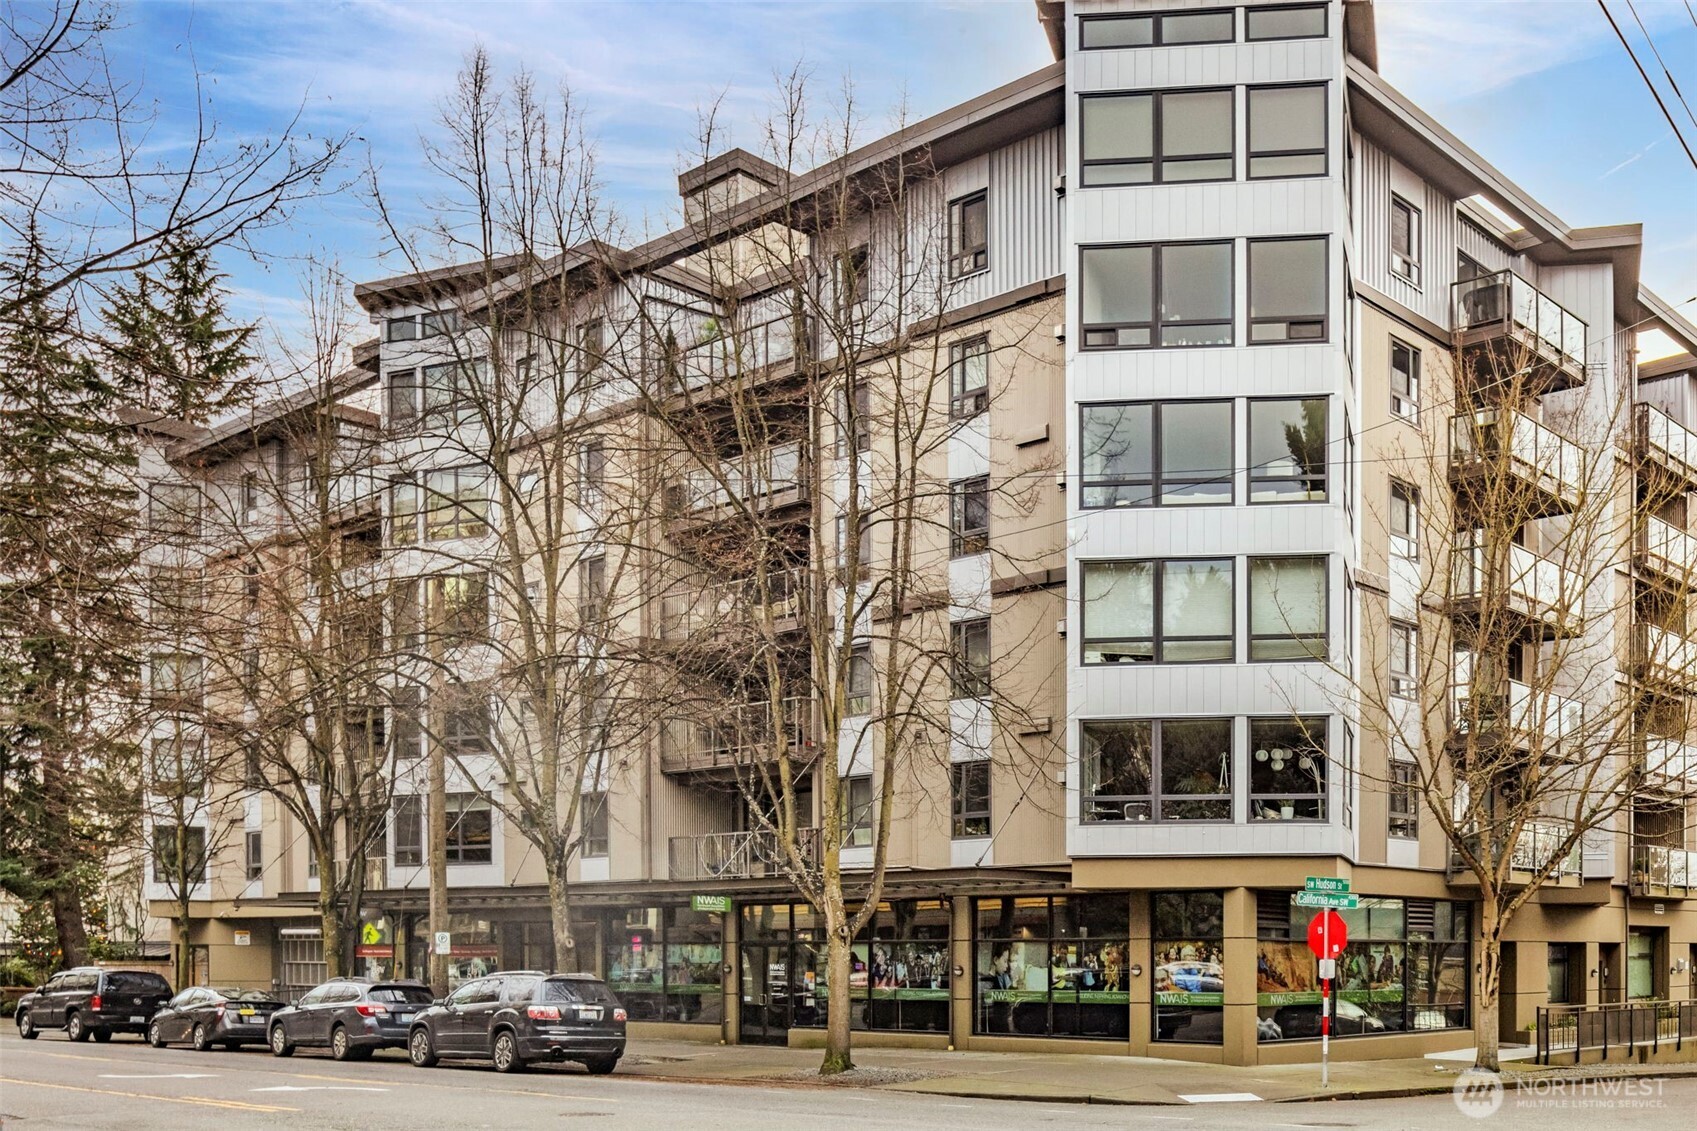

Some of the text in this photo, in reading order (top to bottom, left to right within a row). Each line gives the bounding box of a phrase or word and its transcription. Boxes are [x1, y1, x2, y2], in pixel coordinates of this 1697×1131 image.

[1315, 878, 1336, 889] Hudson
[697, 895, 726, 904] NWAIS
[1299, 892, 1328, 904] California
[1329, 897, 1339, 906] Ave
[1339, 898, 1348, 906] SW
[769, 963, 785, 971] NWAIS
[1160, 993, 1189, 1004] NWAIS
[1270, 994, 1293, 1005] NWAIS
